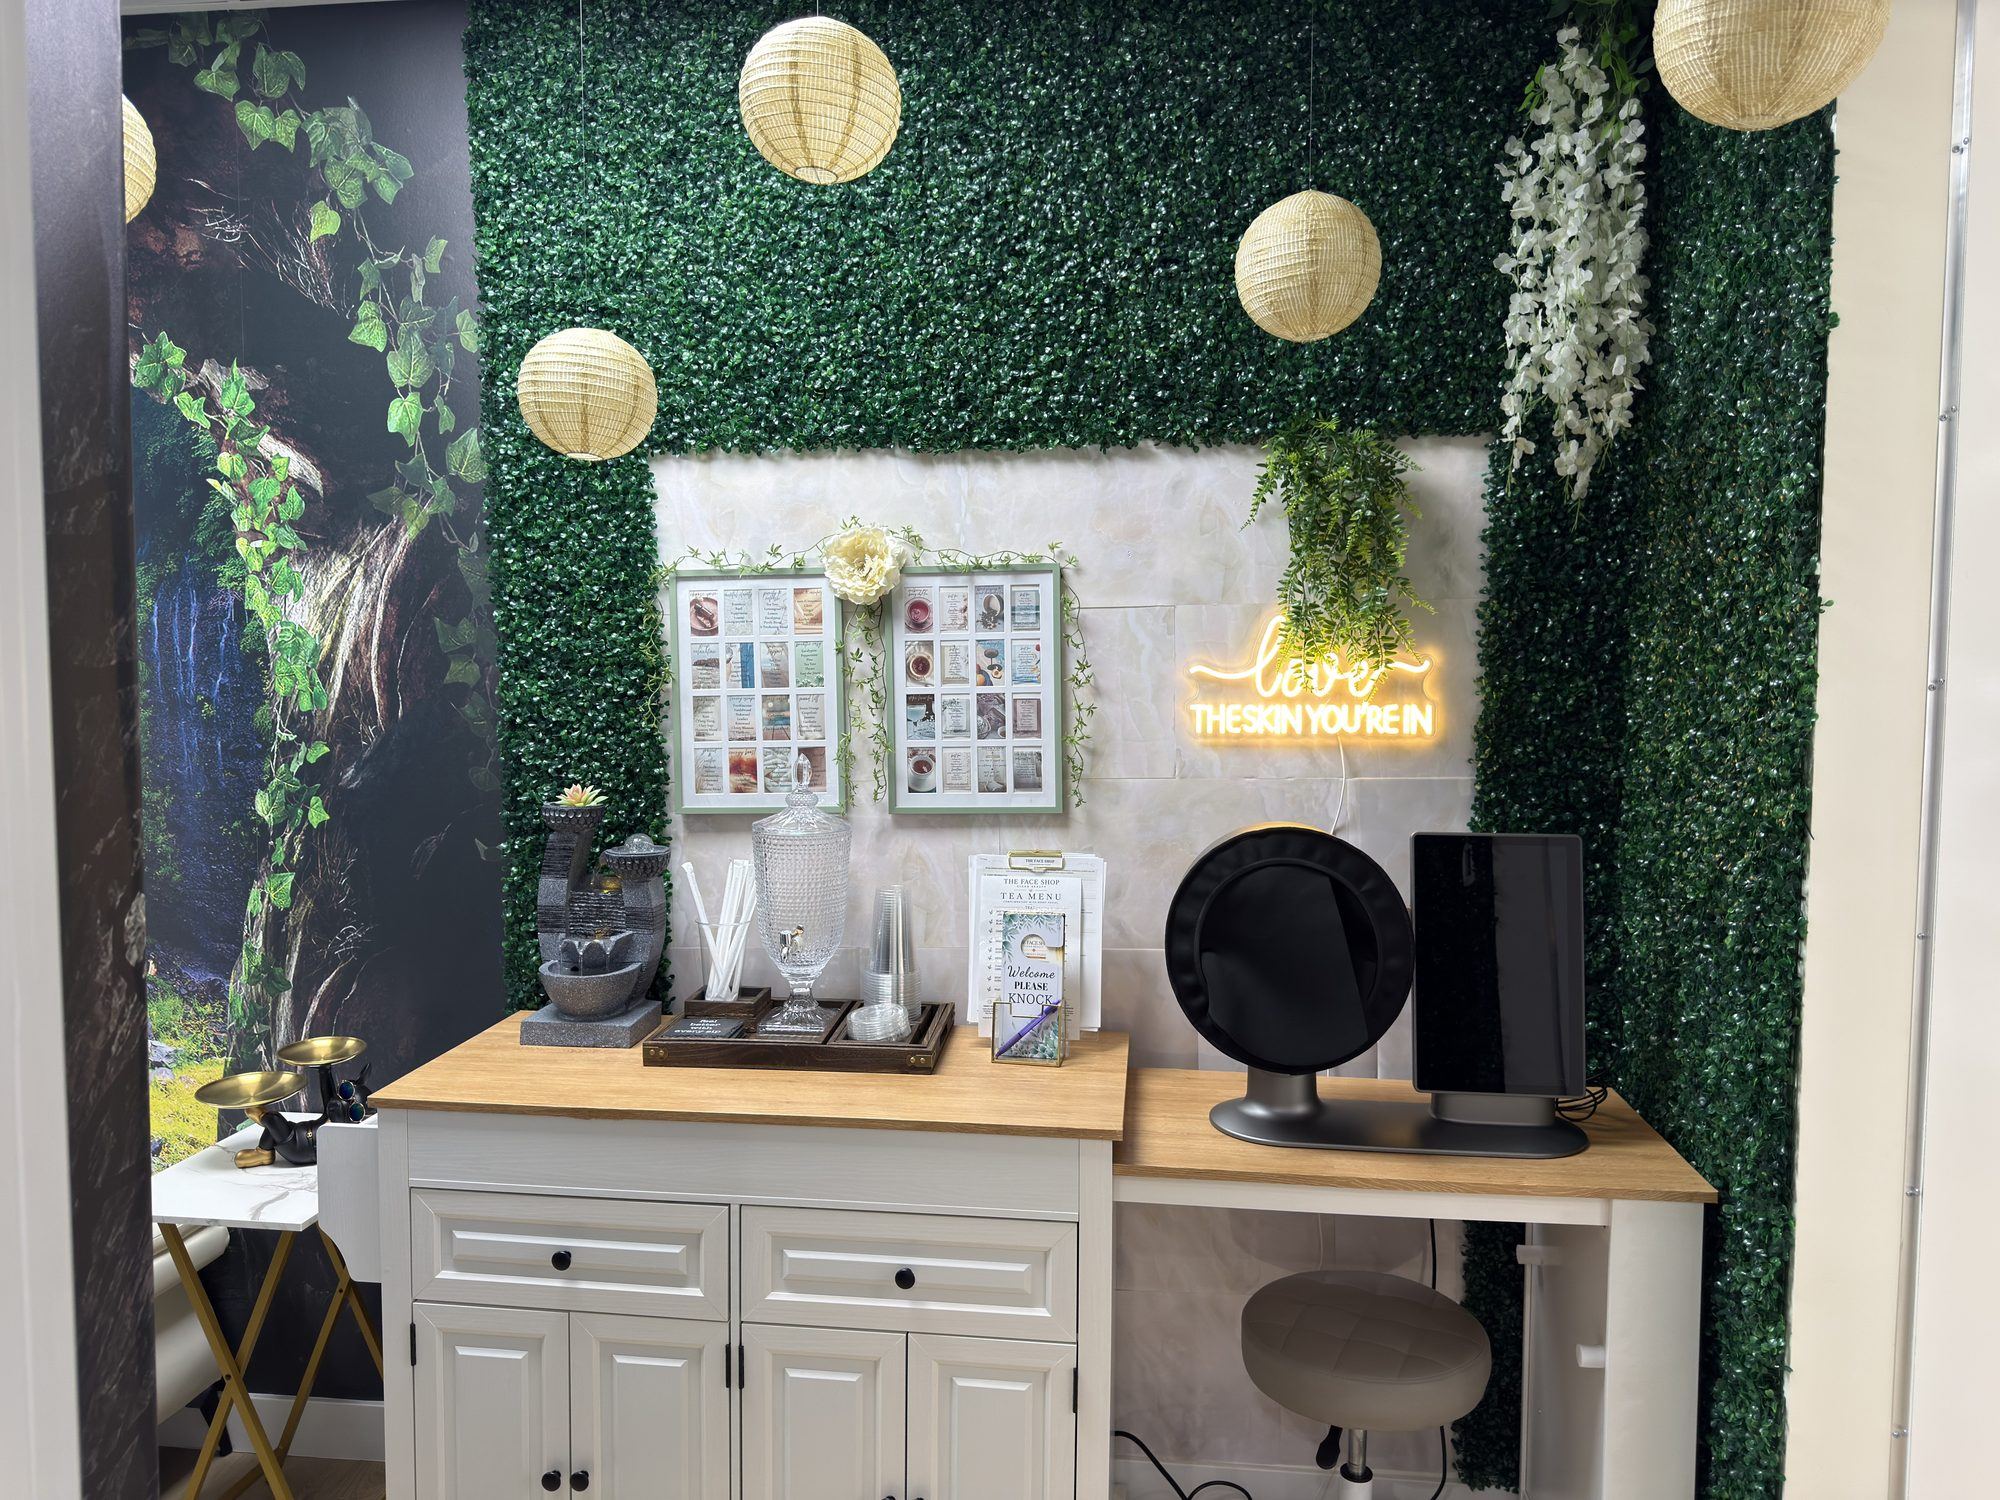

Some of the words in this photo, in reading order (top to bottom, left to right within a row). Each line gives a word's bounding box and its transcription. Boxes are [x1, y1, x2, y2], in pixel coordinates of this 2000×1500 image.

[1189, 615, 1431, 698] love
[1304, 703, 1400, 735] YOU'RE
[1402, 703, 1433, 735] IN
[1000, 892, 1023, 900] TEA
[1028, 892, 1062, 901] MENU
[1007, 965, 1056, 979] Welcome
[1014, 981, 1049, 991] PLEASE
[1008, 992, 1054, 1006] KNOCK
